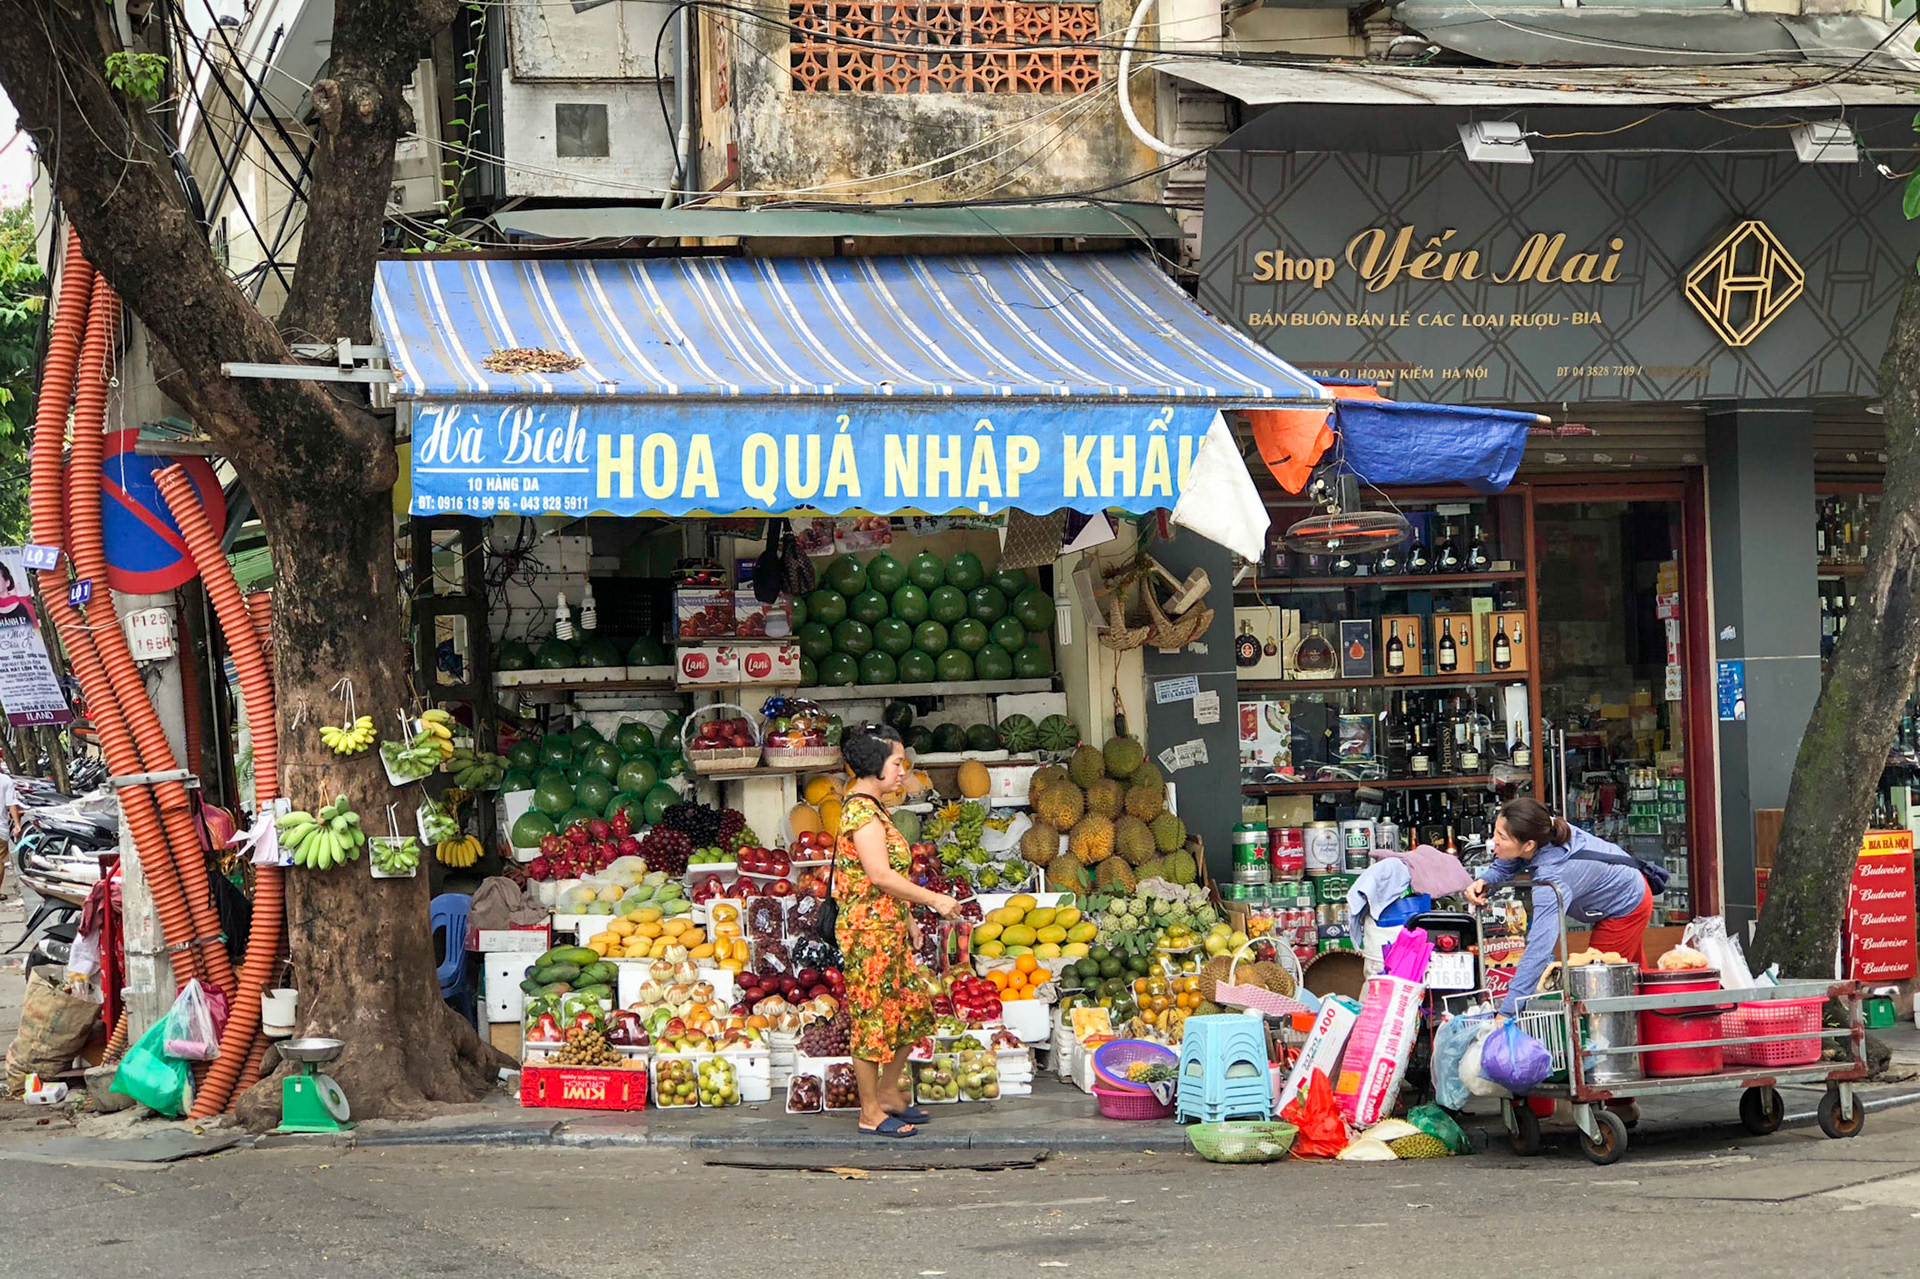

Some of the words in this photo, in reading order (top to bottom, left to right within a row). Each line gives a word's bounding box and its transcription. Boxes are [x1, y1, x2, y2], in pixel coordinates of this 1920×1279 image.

[1254, 249, 1335, 289] Shop
[1345, 224, 1486, 292] Yến
[1491, 232, 1623, 285] Mai
[1249, 309, 1288, 326] BÁN
[1290, 310, 1341, 326] BUÔN
[1346, 309, 1384, 326] BÁN
[1389, 309, 1410, 326] LẺ
[1417, 310, 1456, 326] CÁC
[1462, 313, 1504, 331] LOẠI
[1400, 365, 1434, 379] KIẾM
[1442, 366, 1461, 379] HÀ
[1465, 365, 1488, 380] NỘI
[1572, 366, 1584, 376] 04
[1587, 366, 1609, 376] 3828
[1612, 366, 1635, 376] 7209
[418, 405, 487, 466] Hà
[498, 403, 590, 466] Bích
[597, 432, 719, 500] HOA
[740, 414, 861, 508] QUẢ
[884, 418, 1041, 513] NHẬP
[467, 477, 482, 491] 10
[486, 474, 519, 491] HÀNG
[523, 477, 539, 491] DA
[437, 496, 463, 510] 0916
[466, 496, 479, 510] 19
[481, 496, 495, 510] 59
[497, 496, 510, 510] 56
[520, 496, 540, 510] 043
[542, 496, 562, 510] 828
[564, 495, 588, 510] 5911
[27, 548, 44, 565] LỘ
[45, 552, 56, 564] 2
[71, 584, 82, 600] LỘ
[83, 584, 89, 597] 1
[1442, 727, 1452, 773] Hennessy
[1868, 839, 1882, 850] BIA
[1882, 837, 1894, 849] HÀ
[1859, 864, 1906, 876] Budweiser
[1859, 888, 1907, 901] Budweiser
[1860, 913, 1907, 925] Budweiser
[1860, 937, 1908, 950] Budweiser
[1861, 962, 1909, 974] Budweiser
[1319, 1008, 1336, 1035] 400
[564, 1080, 606, 1089] CRUNCH
[563, 1086, 605, 1101] KIWI
